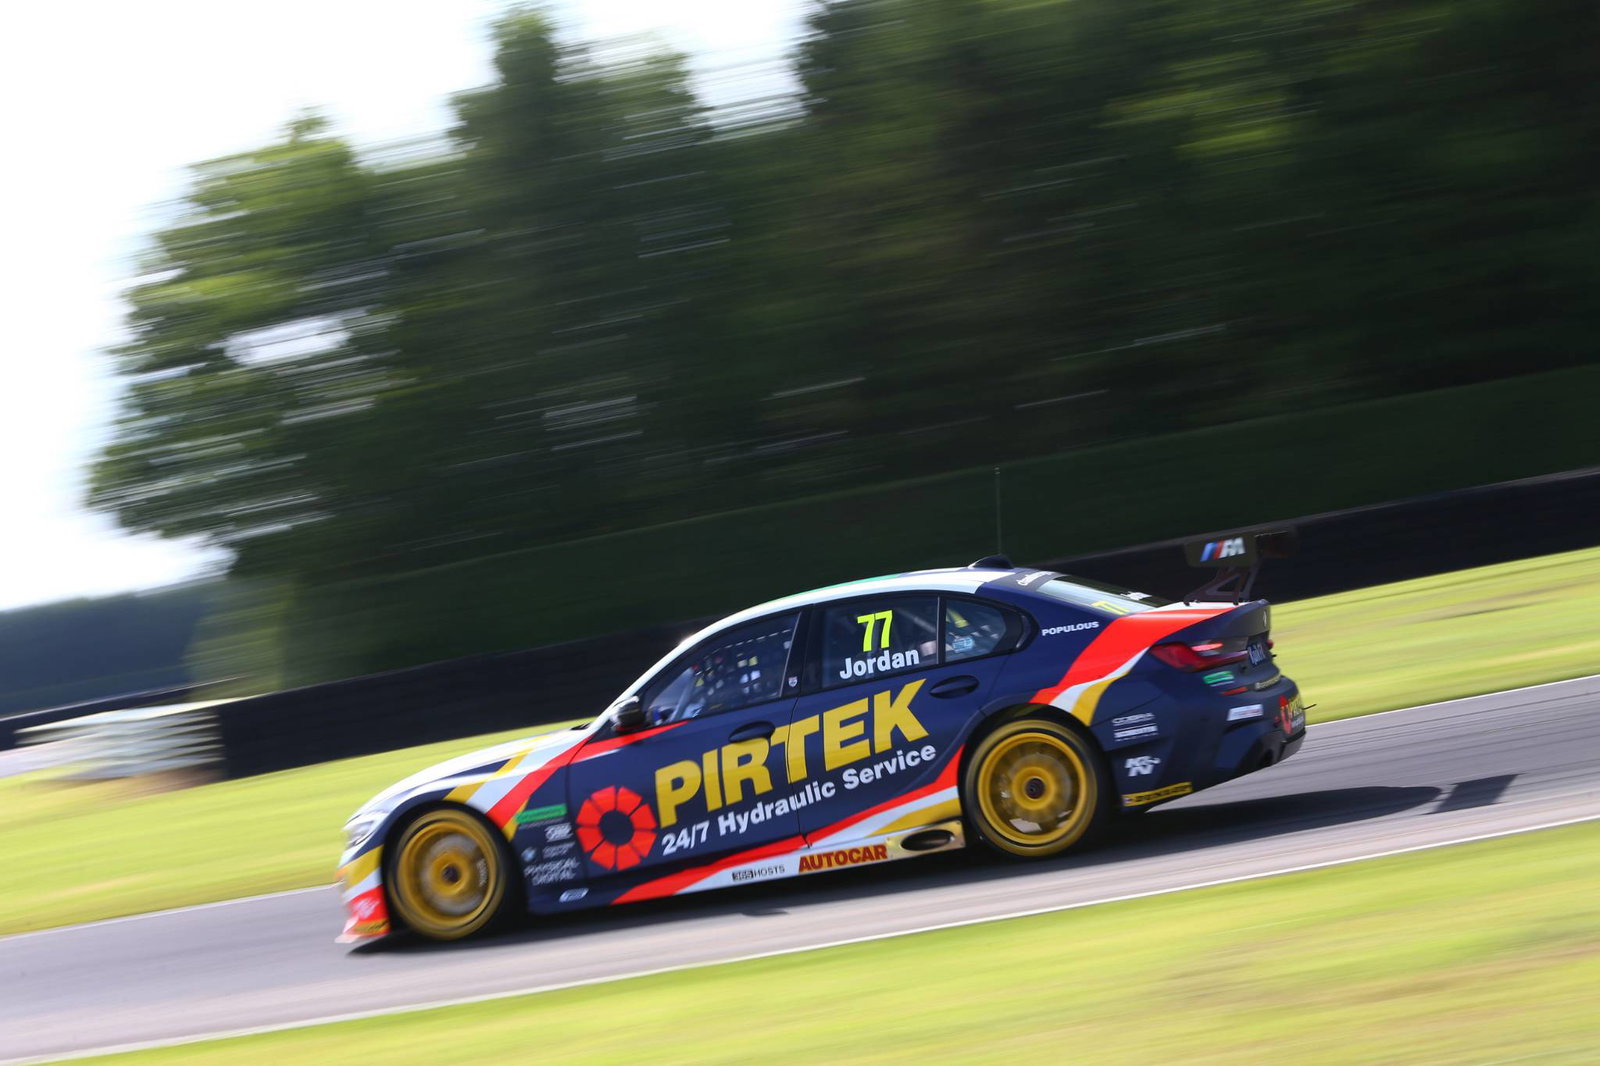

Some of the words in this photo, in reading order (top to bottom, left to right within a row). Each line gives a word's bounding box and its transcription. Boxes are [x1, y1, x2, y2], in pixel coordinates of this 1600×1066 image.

[857, 610, 893, 652] 77
[1042, 621, 1099, 636] POPULOUS
[839, 649, 920, 679] Jordan
[655, 678, 929, 829] PIRTEK
[661, 821, 709, 855] 24/7
[718, 780, 836, 837] Hydraulic
[842, 744, 937, 790] Service
[799, 844, 888, 874] AUTOCAR
